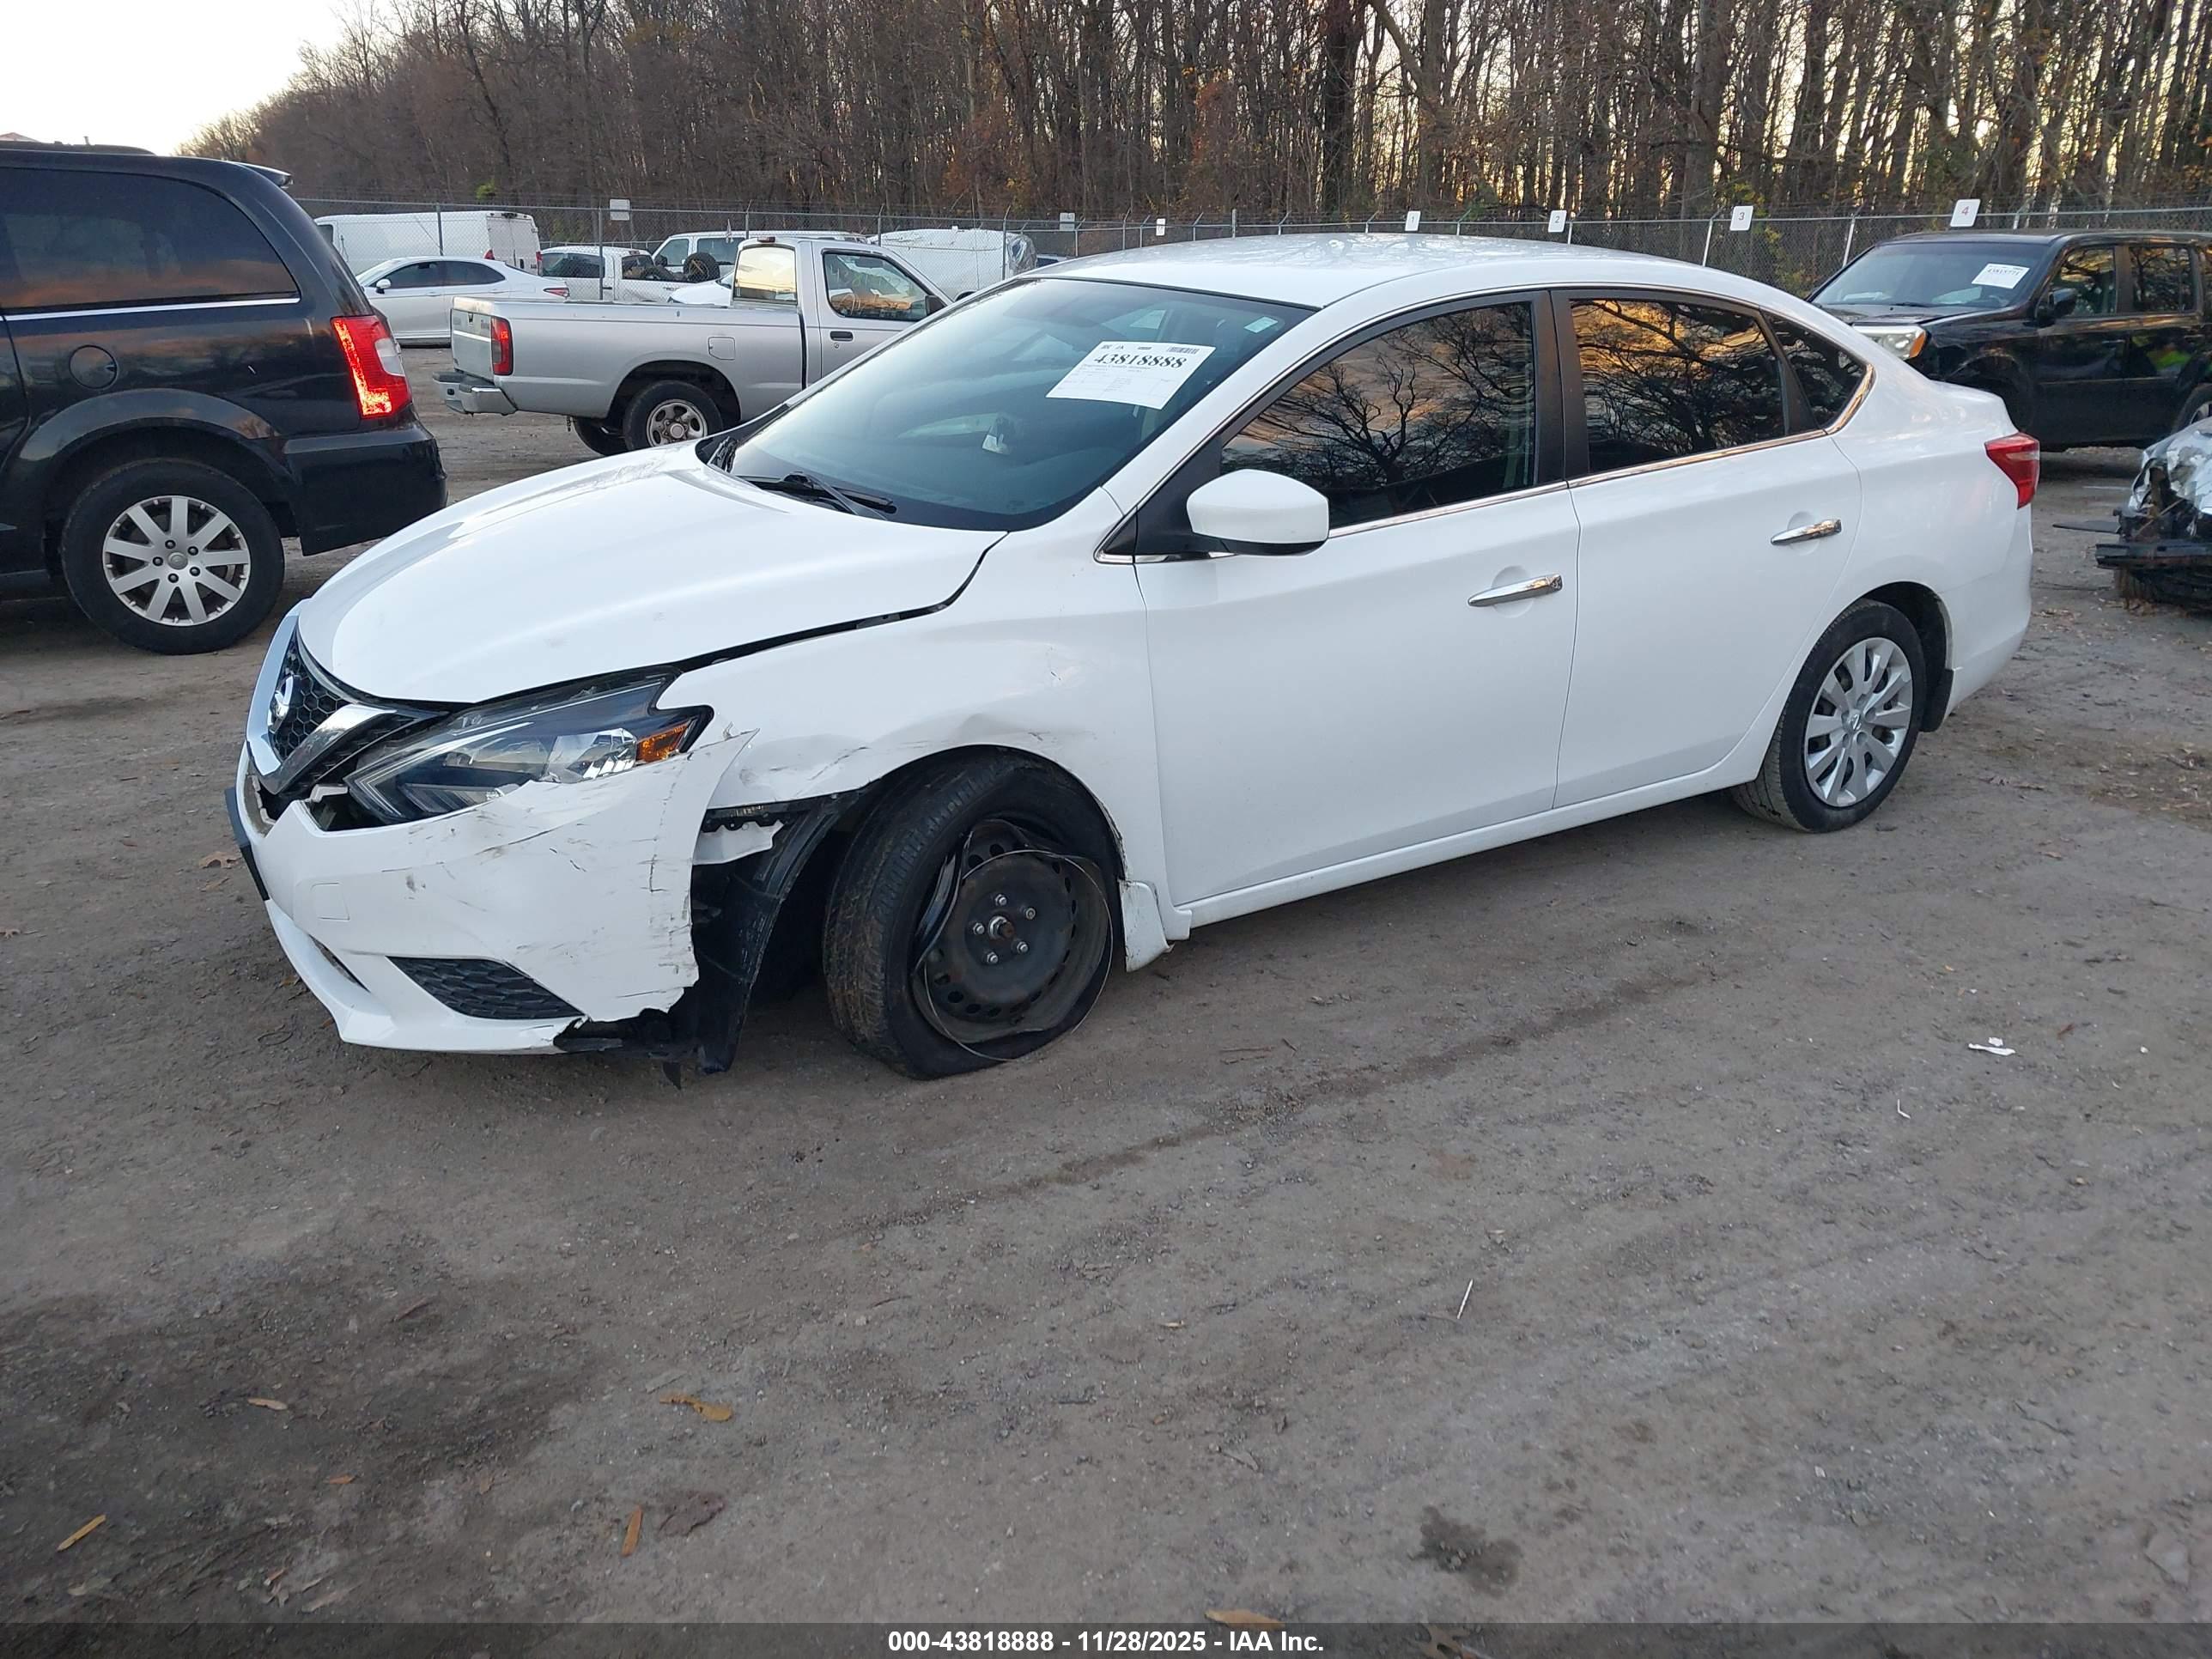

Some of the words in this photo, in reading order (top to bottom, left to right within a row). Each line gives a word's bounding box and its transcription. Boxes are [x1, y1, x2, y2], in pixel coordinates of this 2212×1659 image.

[1960, 205, 1970, 216] 4
[1554, 215, 1561, 224] 2
[1737, 211, 1746, 221] 3
[1094, 353, 1188, 369] 43818888
